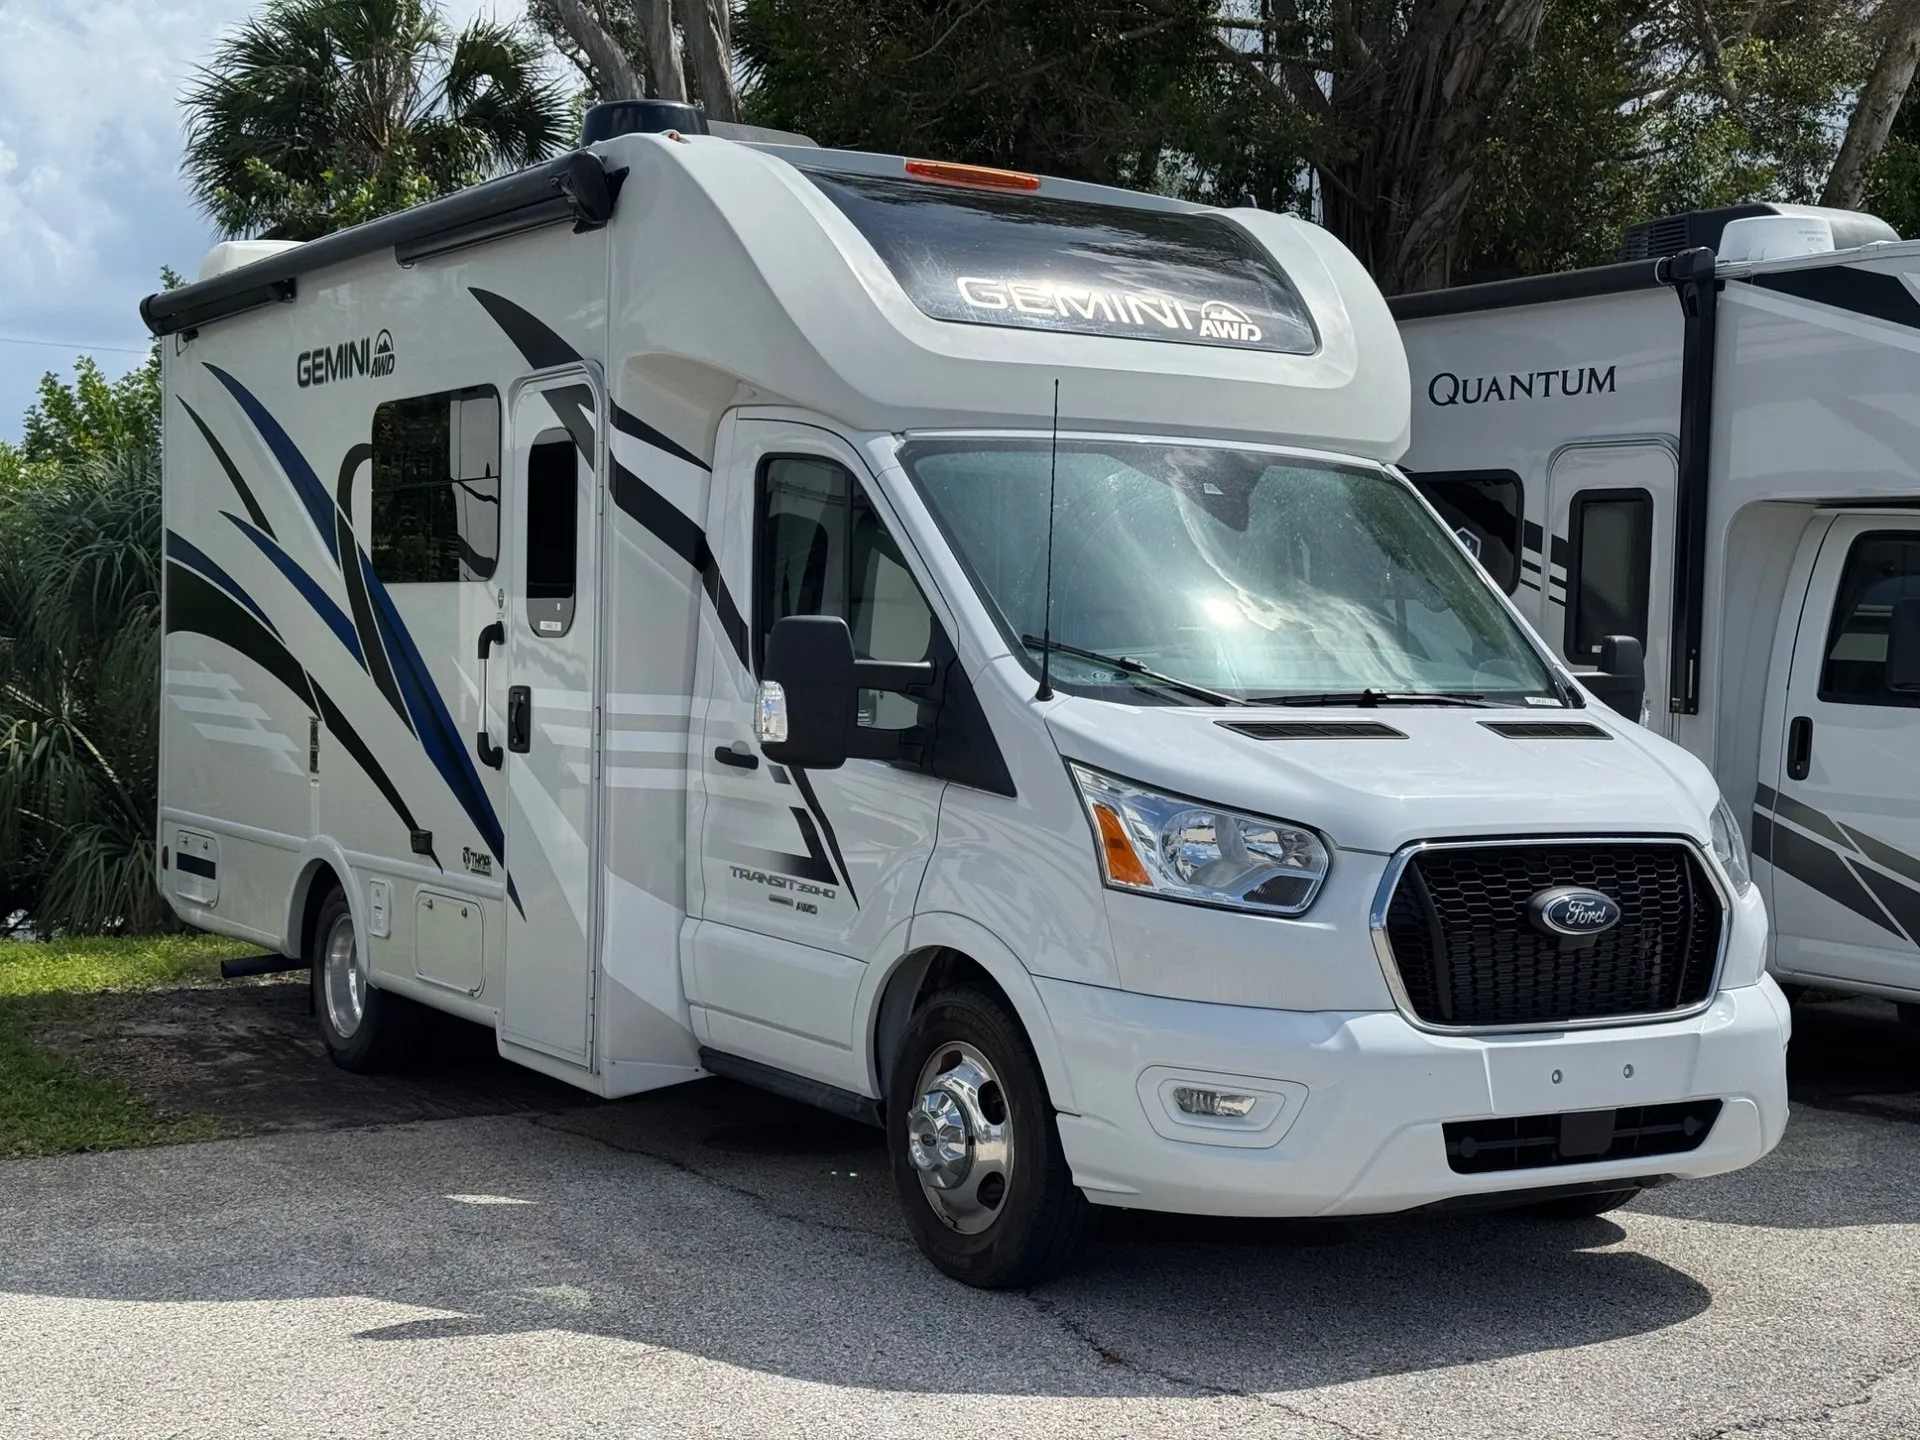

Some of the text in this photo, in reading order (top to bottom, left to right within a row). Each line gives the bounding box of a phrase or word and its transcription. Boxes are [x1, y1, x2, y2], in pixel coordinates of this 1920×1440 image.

[957, 276, 1262, 342] GEMINI AWD
[297, 336, 396, 389] GEMINI AWD
[729, 866, 798, 891] TRANSIT
[796, 901, 818, 915] AWD
[1565, 900, 1607, 924] Ford
